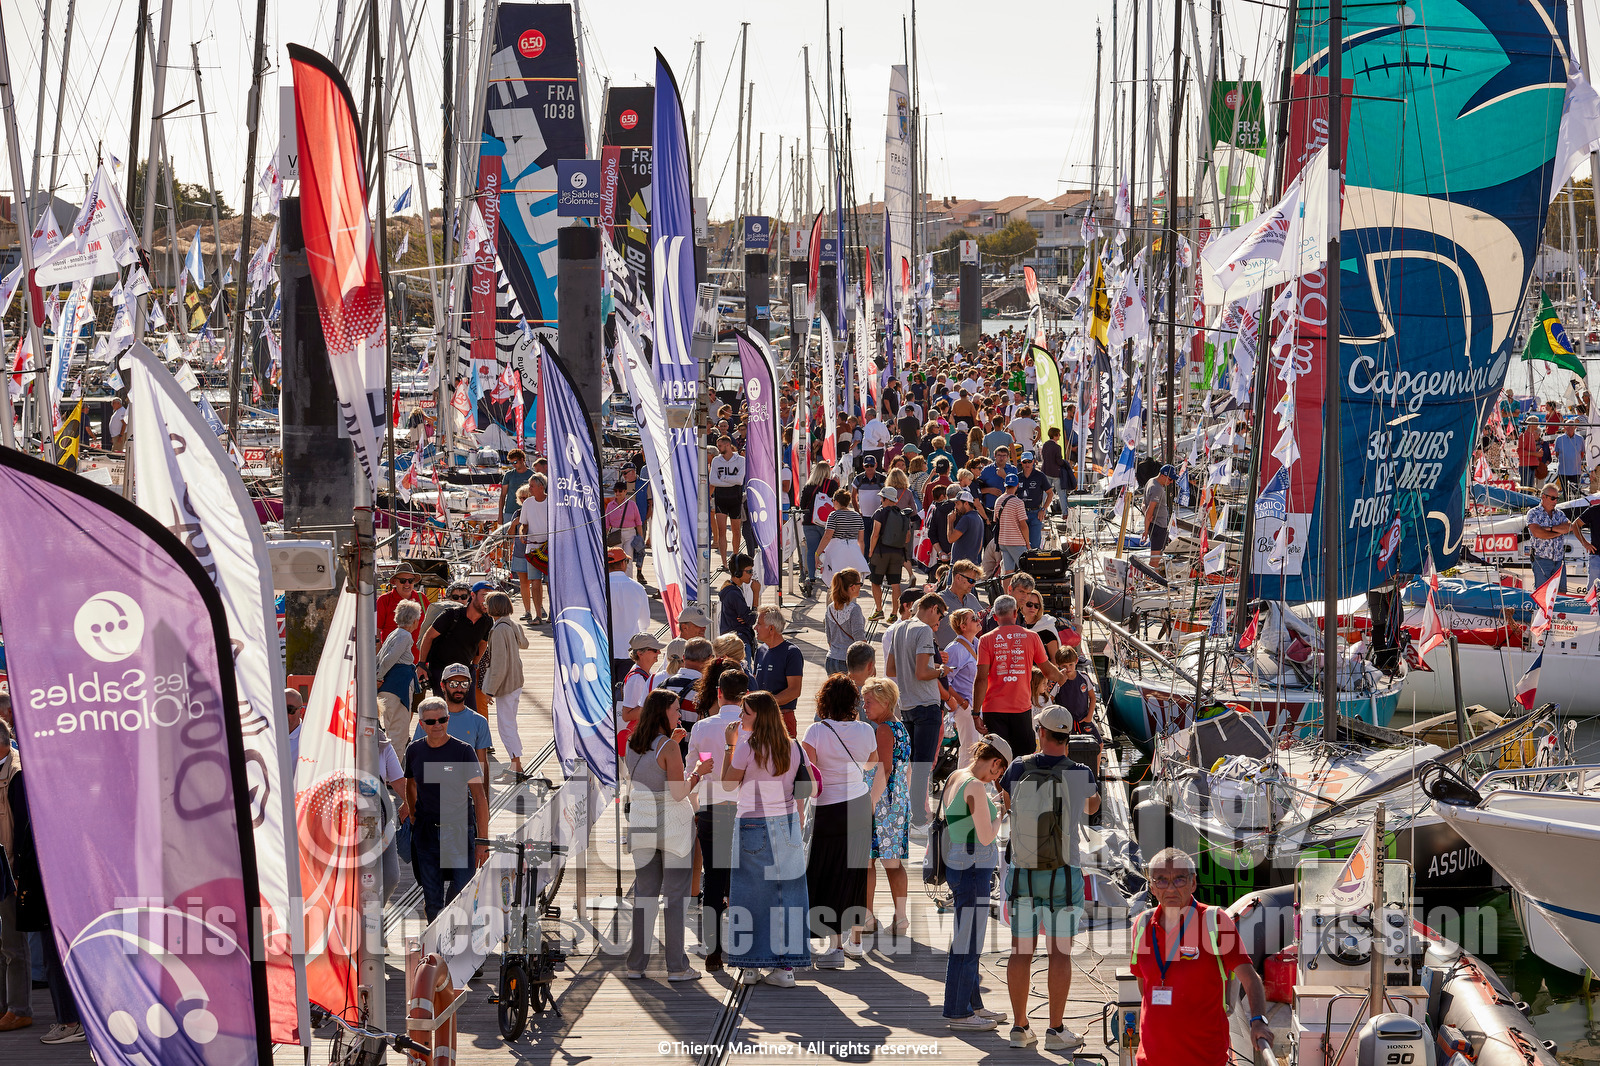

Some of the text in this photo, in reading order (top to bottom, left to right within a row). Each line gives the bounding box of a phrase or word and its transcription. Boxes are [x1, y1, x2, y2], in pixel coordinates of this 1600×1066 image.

[521, 36, 543, 49] 6.50
[547, 85, 575, 100] FRA
[543, 103, 575, 119] 1038
[621, 114, 637, 123] 6.50
[1237, 121, 1260, 132] FRA
[1239, 133, 1260, 145] 915
[571, 190, 599, 199] Sables
[473, 278, 491, 296] la
[517, 356, 529, 379] BUILD
[1348, 355, 1487, 413] Capgemini
[1367, 430, 1454, 461] 30 JOURS
[246, 450, 264, 460] 759
[718, 466, 739, 476] FILA
[1375, 460, 1443, 494] DE MER
[1349, 493, 1392, 529] POUR
[1478, 536, 1513, 550] 1040
[1386, 1052, 1415, 1065] 90
